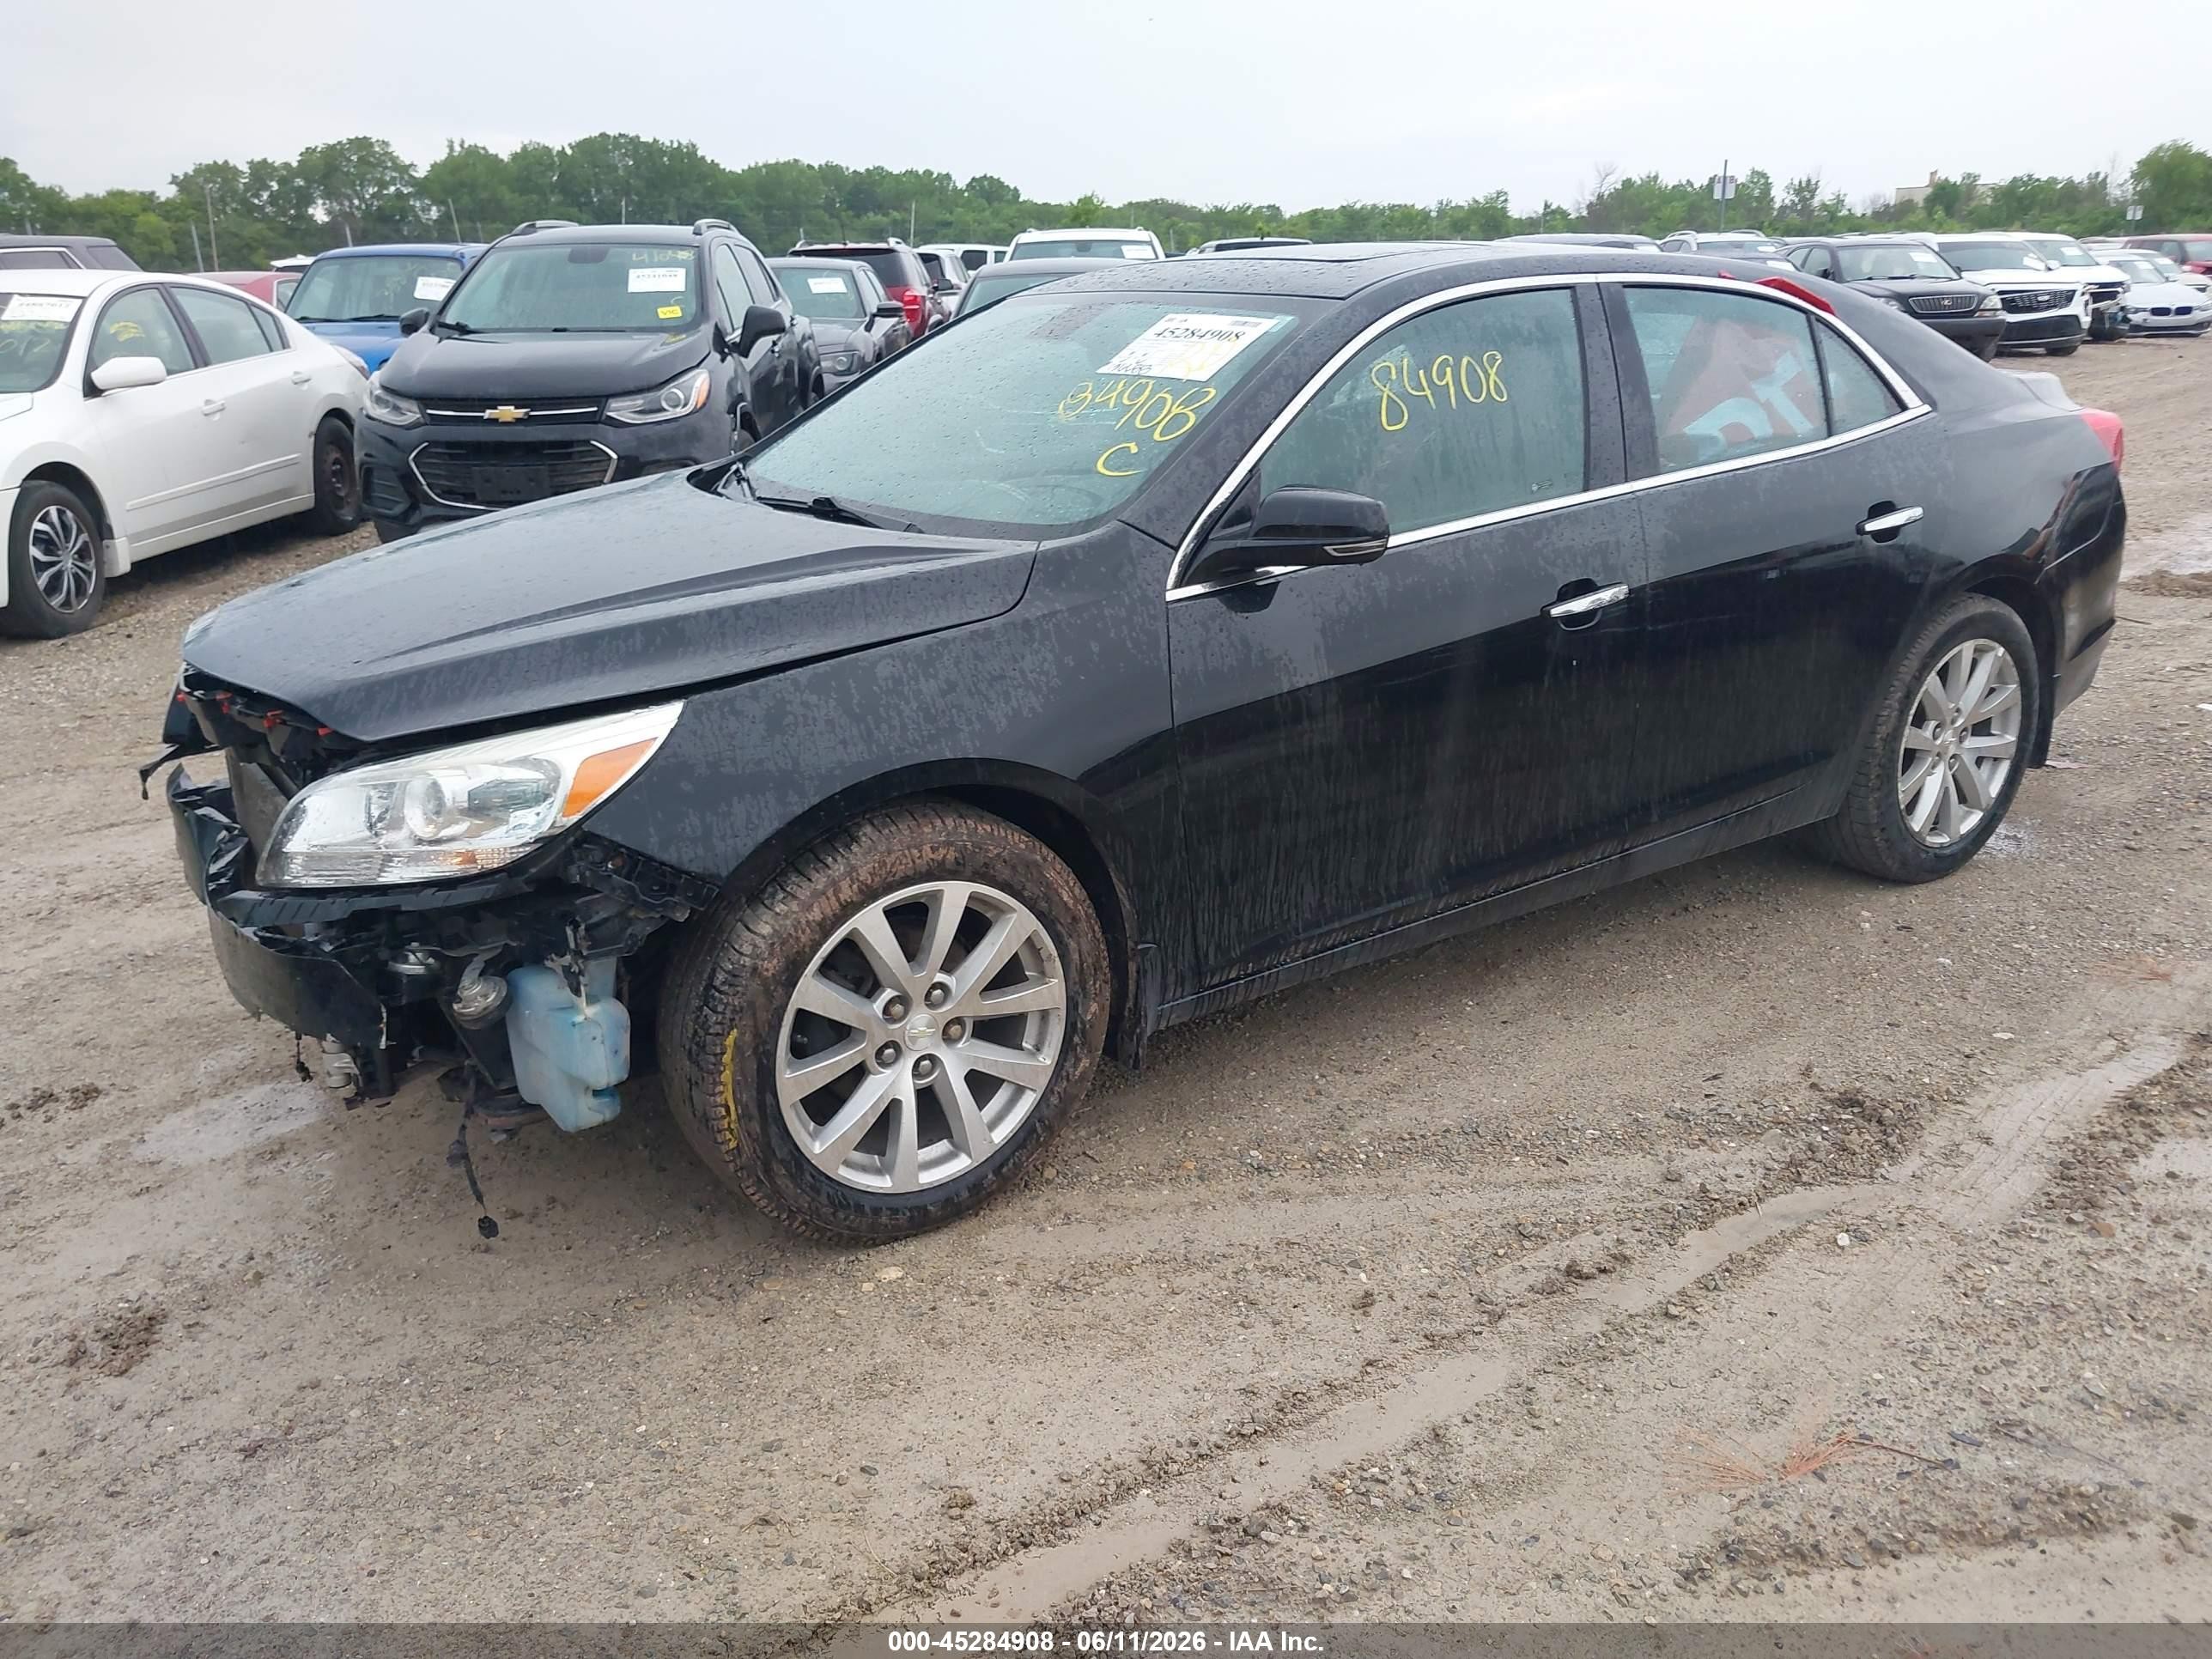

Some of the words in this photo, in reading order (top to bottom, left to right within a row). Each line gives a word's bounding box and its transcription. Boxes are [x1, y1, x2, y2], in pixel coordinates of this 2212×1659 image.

[1154, 327, 1246, 343] 45284908
[1370, 350, 1508, 431] 84908
[1094, 442, 1148, 477] C
